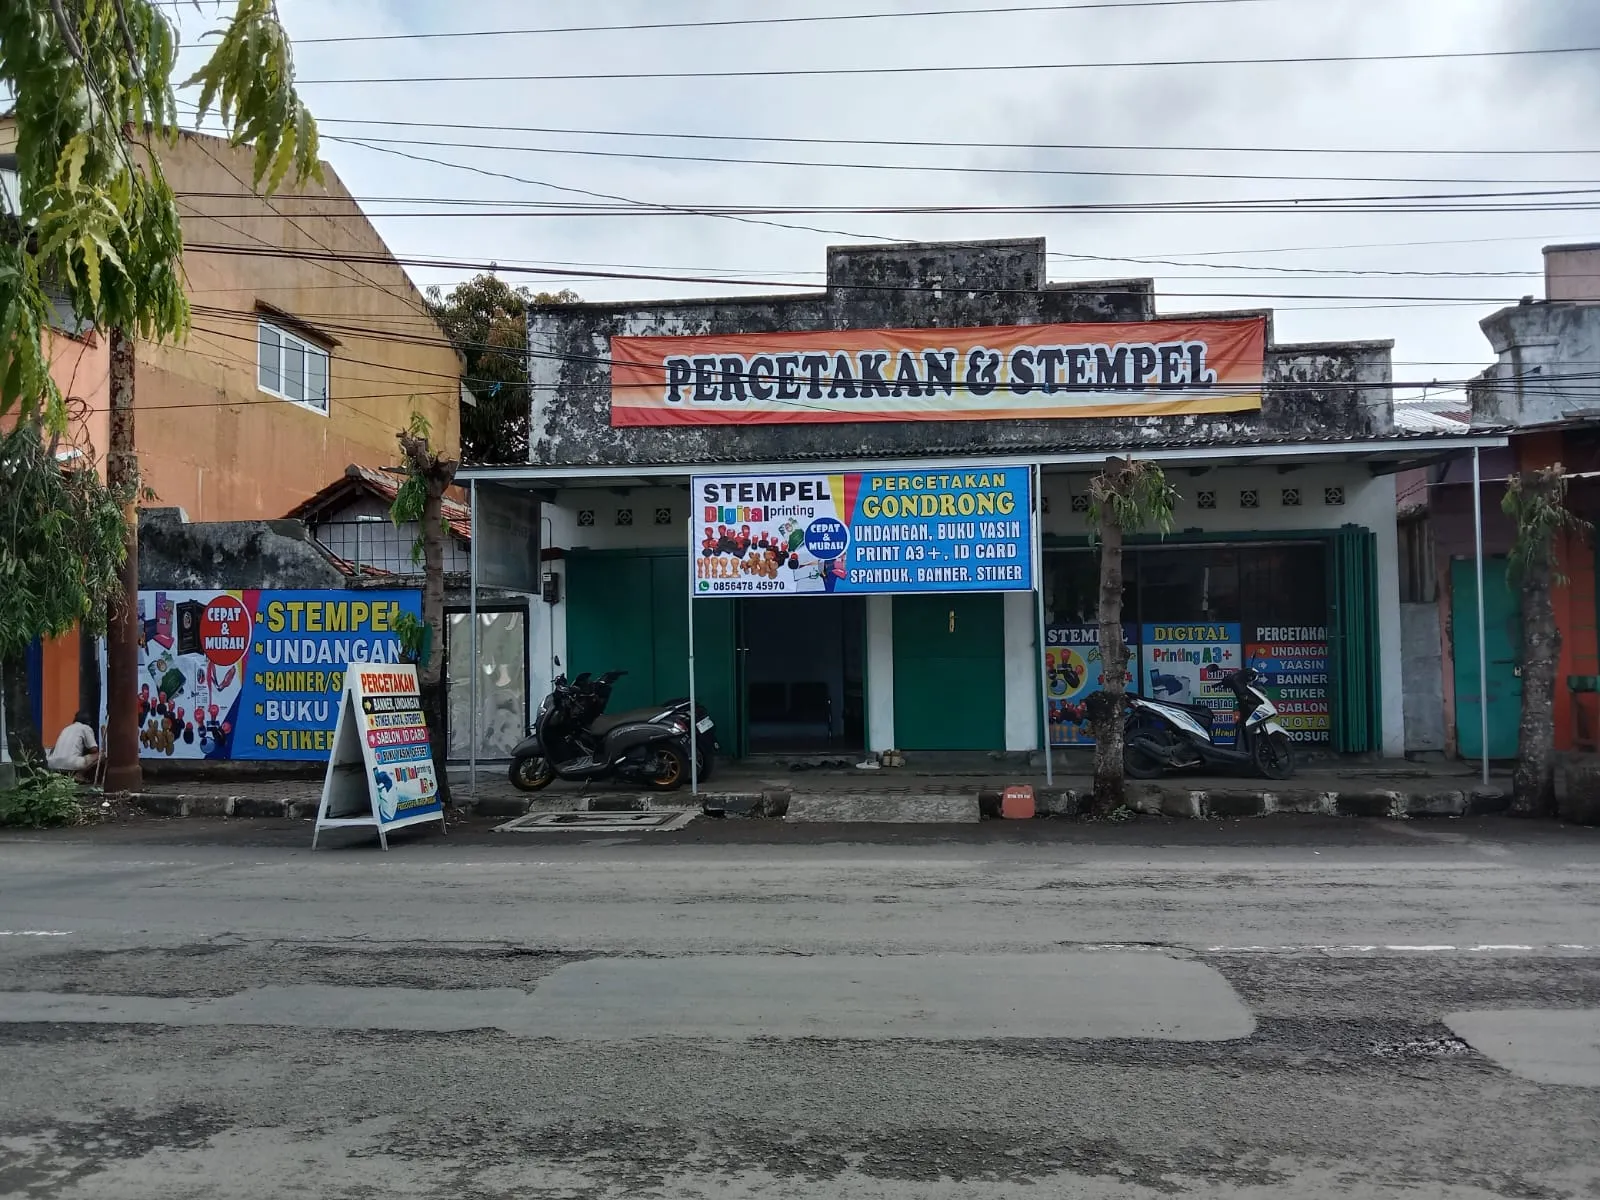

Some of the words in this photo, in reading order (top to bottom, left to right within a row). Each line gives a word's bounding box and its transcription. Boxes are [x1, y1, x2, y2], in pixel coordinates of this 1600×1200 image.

[666, 350, 958, 402] PERCETAKAN
[966, 350, 998, 396] &
[1009, 345, 1214, 396] STEMPEL
[871, 473, 1006, 491] PERCETAKAN
[703, 481, 831, 504] STEMPEL
[862, 491, 1016, 518] GONDRONG
[770, 505, 815, 519] printing
[810, 524, 841, 533] CEPAT
[937, 522, 976, 540] BUKU
[979, 520, 1020, 539] YASIN
[822, 533, 831, 541] &
[808, 541, 844, 551] MURAH
[856, 545, 900, 562] PRINT
[954, 543, 970, 559] ID
[975, 543, 1017, 559] CARD
[976, 565, 1022, 581] STIKER
[713, 581, 753, 591] 0856478
[755, 581, 785, 590] 45970
[207, 607, 241, 621] CEPAT
[221, 622, 230, 635] &
[1154, 626, 1229, 641] DIGITAL
[205, 636, 245, 650] MURAH
[266, 639, 403, 664] UNDANGAN
[1280, 660, 1324, 670] YAASIN
[360, 673, 416, 694] PERCETAKAN
[1276, 674, 1328, 684] BANNER
[1280, 688, 1325, 699] STIKER
[266, 700, 329, 722] BUKU
[1278, 702, 1328, 713] SABLON
[402, 730, 410, 742] ID
[410, 729, 426, 741] CARD
